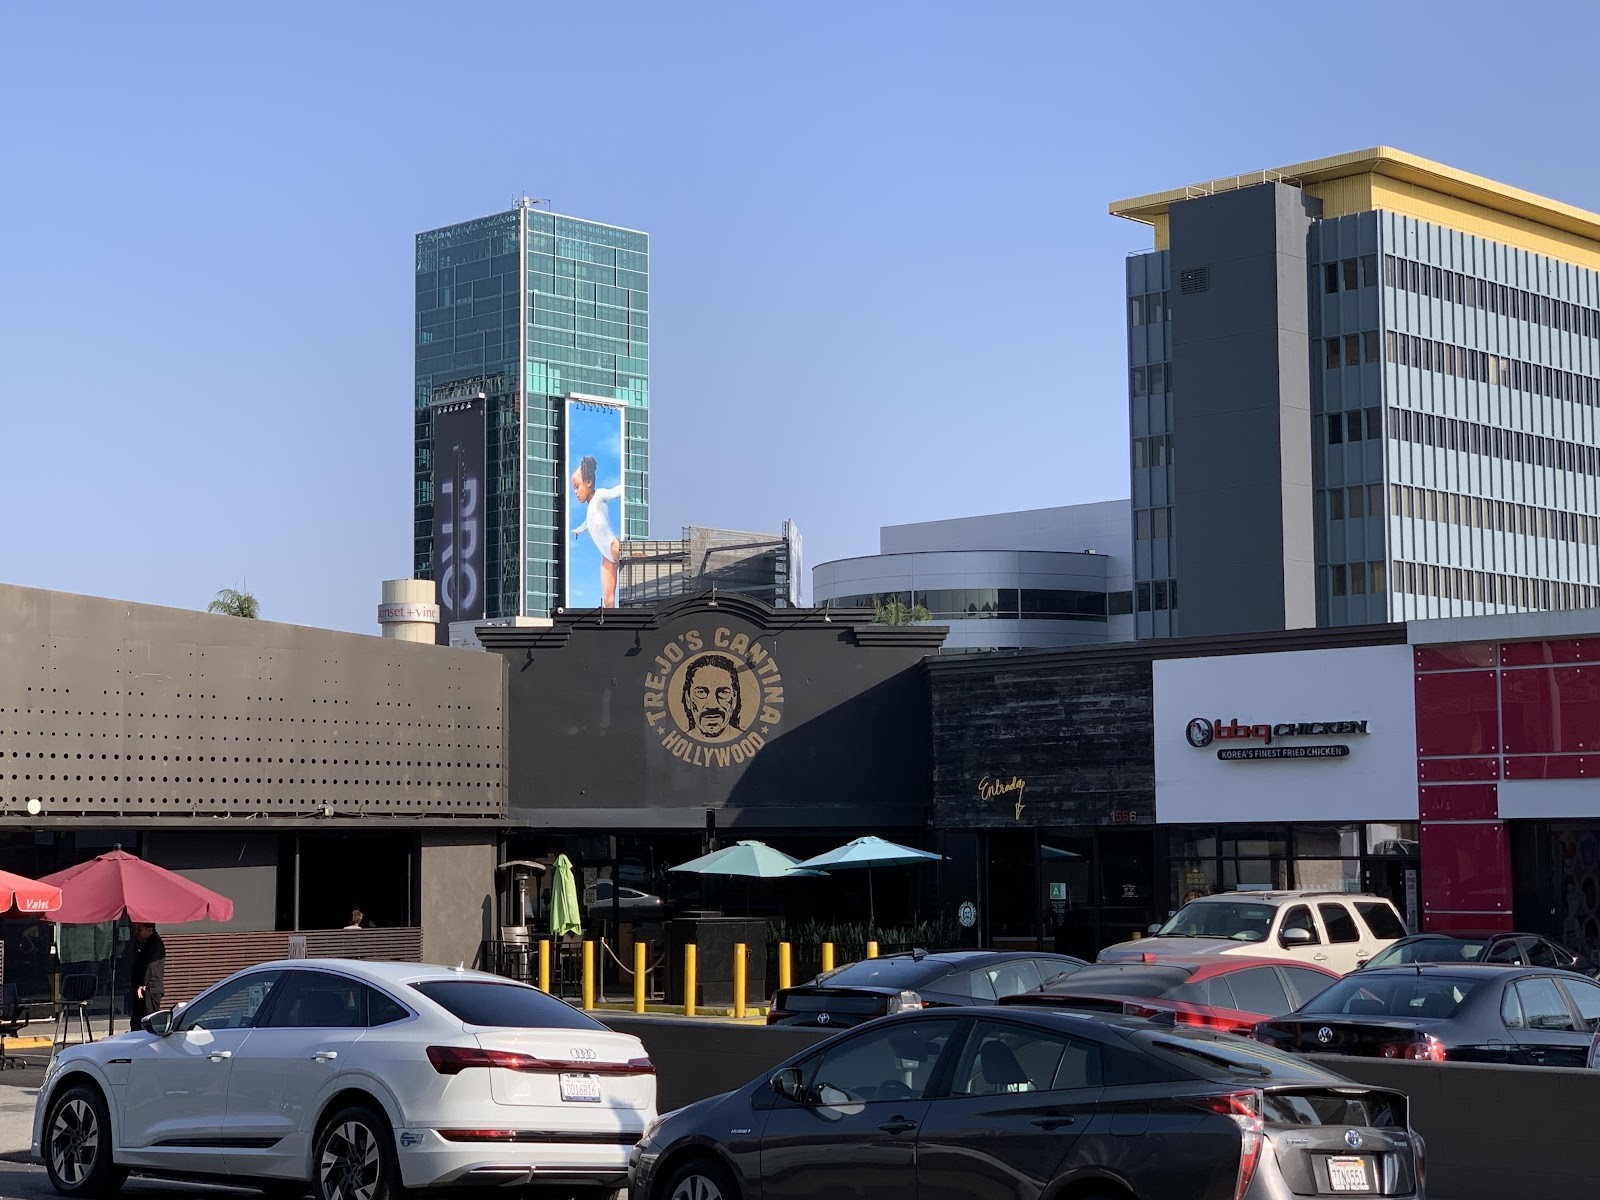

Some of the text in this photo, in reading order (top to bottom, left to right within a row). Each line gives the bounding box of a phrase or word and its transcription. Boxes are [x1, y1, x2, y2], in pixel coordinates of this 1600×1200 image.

[441, 478, 477, 611] PRO
[643, 627, 785, 727] TREJO'S CANTINA
[1273, 720, 1370, 736] CHICKEN
[661, 730, 766, 767] HOLLYWOOD
[1221, 747, 1342, 759] KOREA'S FINEST FRIED CHICKEN
[978, 776, 1026, 802] Entrada
